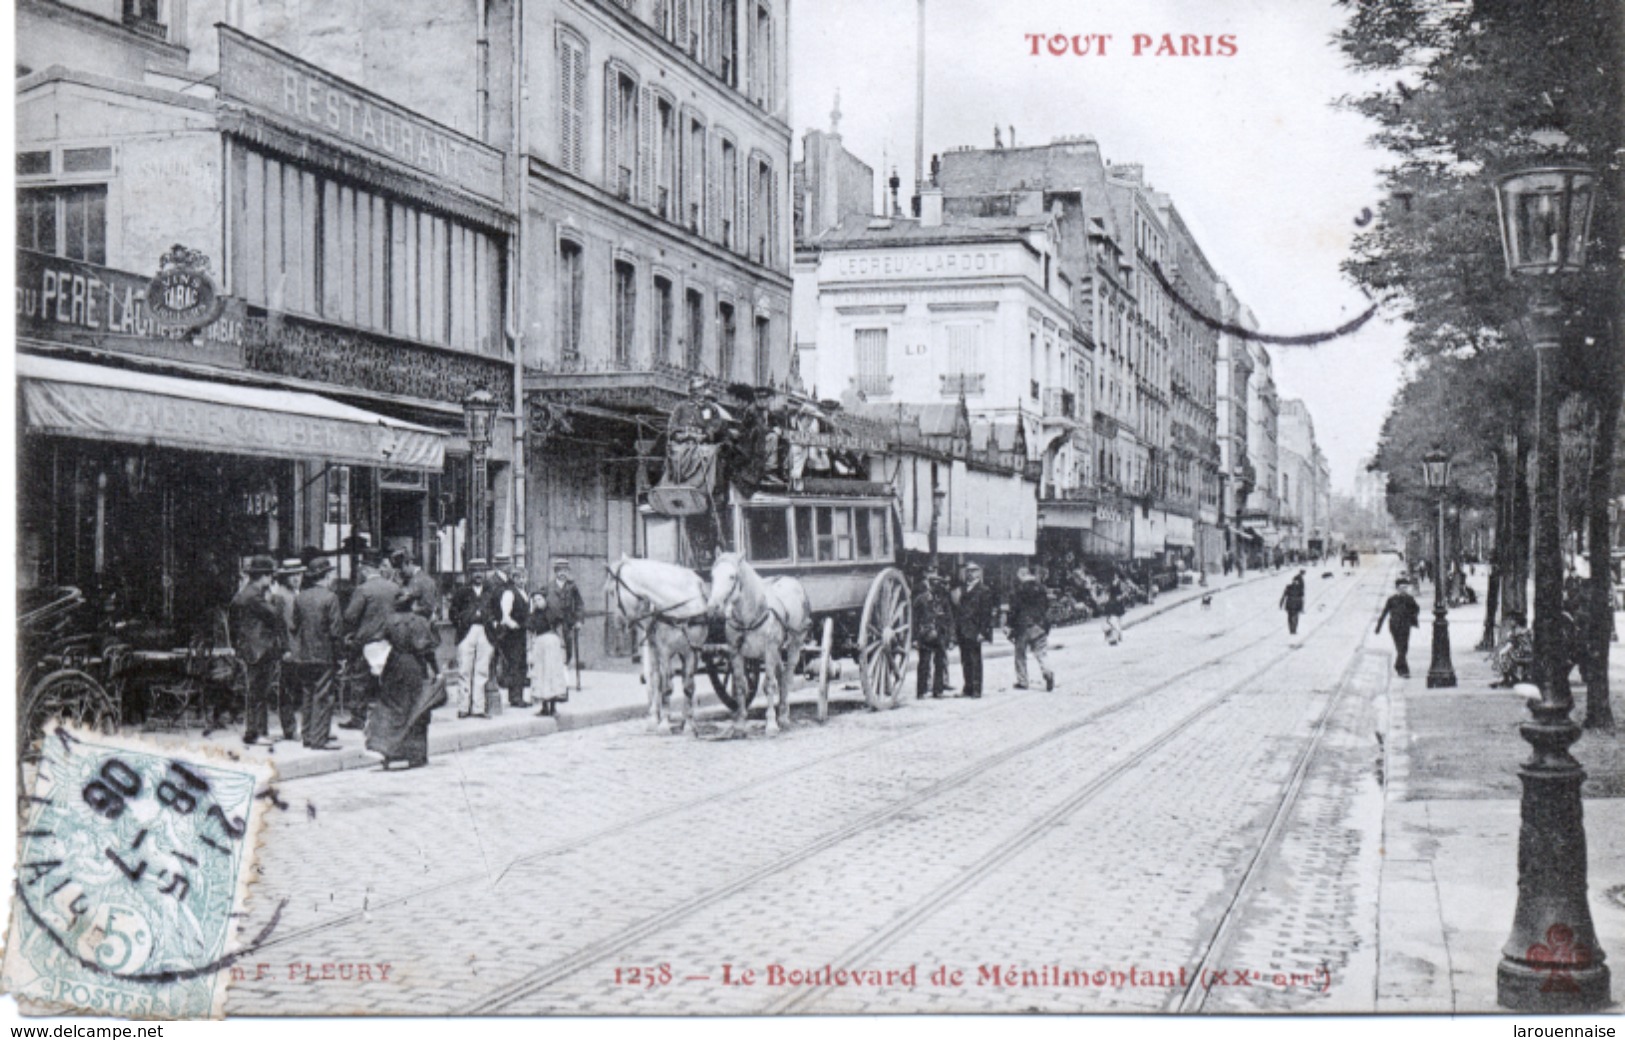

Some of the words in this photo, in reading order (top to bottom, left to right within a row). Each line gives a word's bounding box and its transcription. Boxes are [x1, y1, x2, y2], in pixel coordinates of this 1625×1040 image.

[282, 72, 459, 179] RESTAURANT
[41, 267, 101, 328] PERE
[164, 285, 199, 310] TABAC
[57, 981, 151, 1017] POSTES
